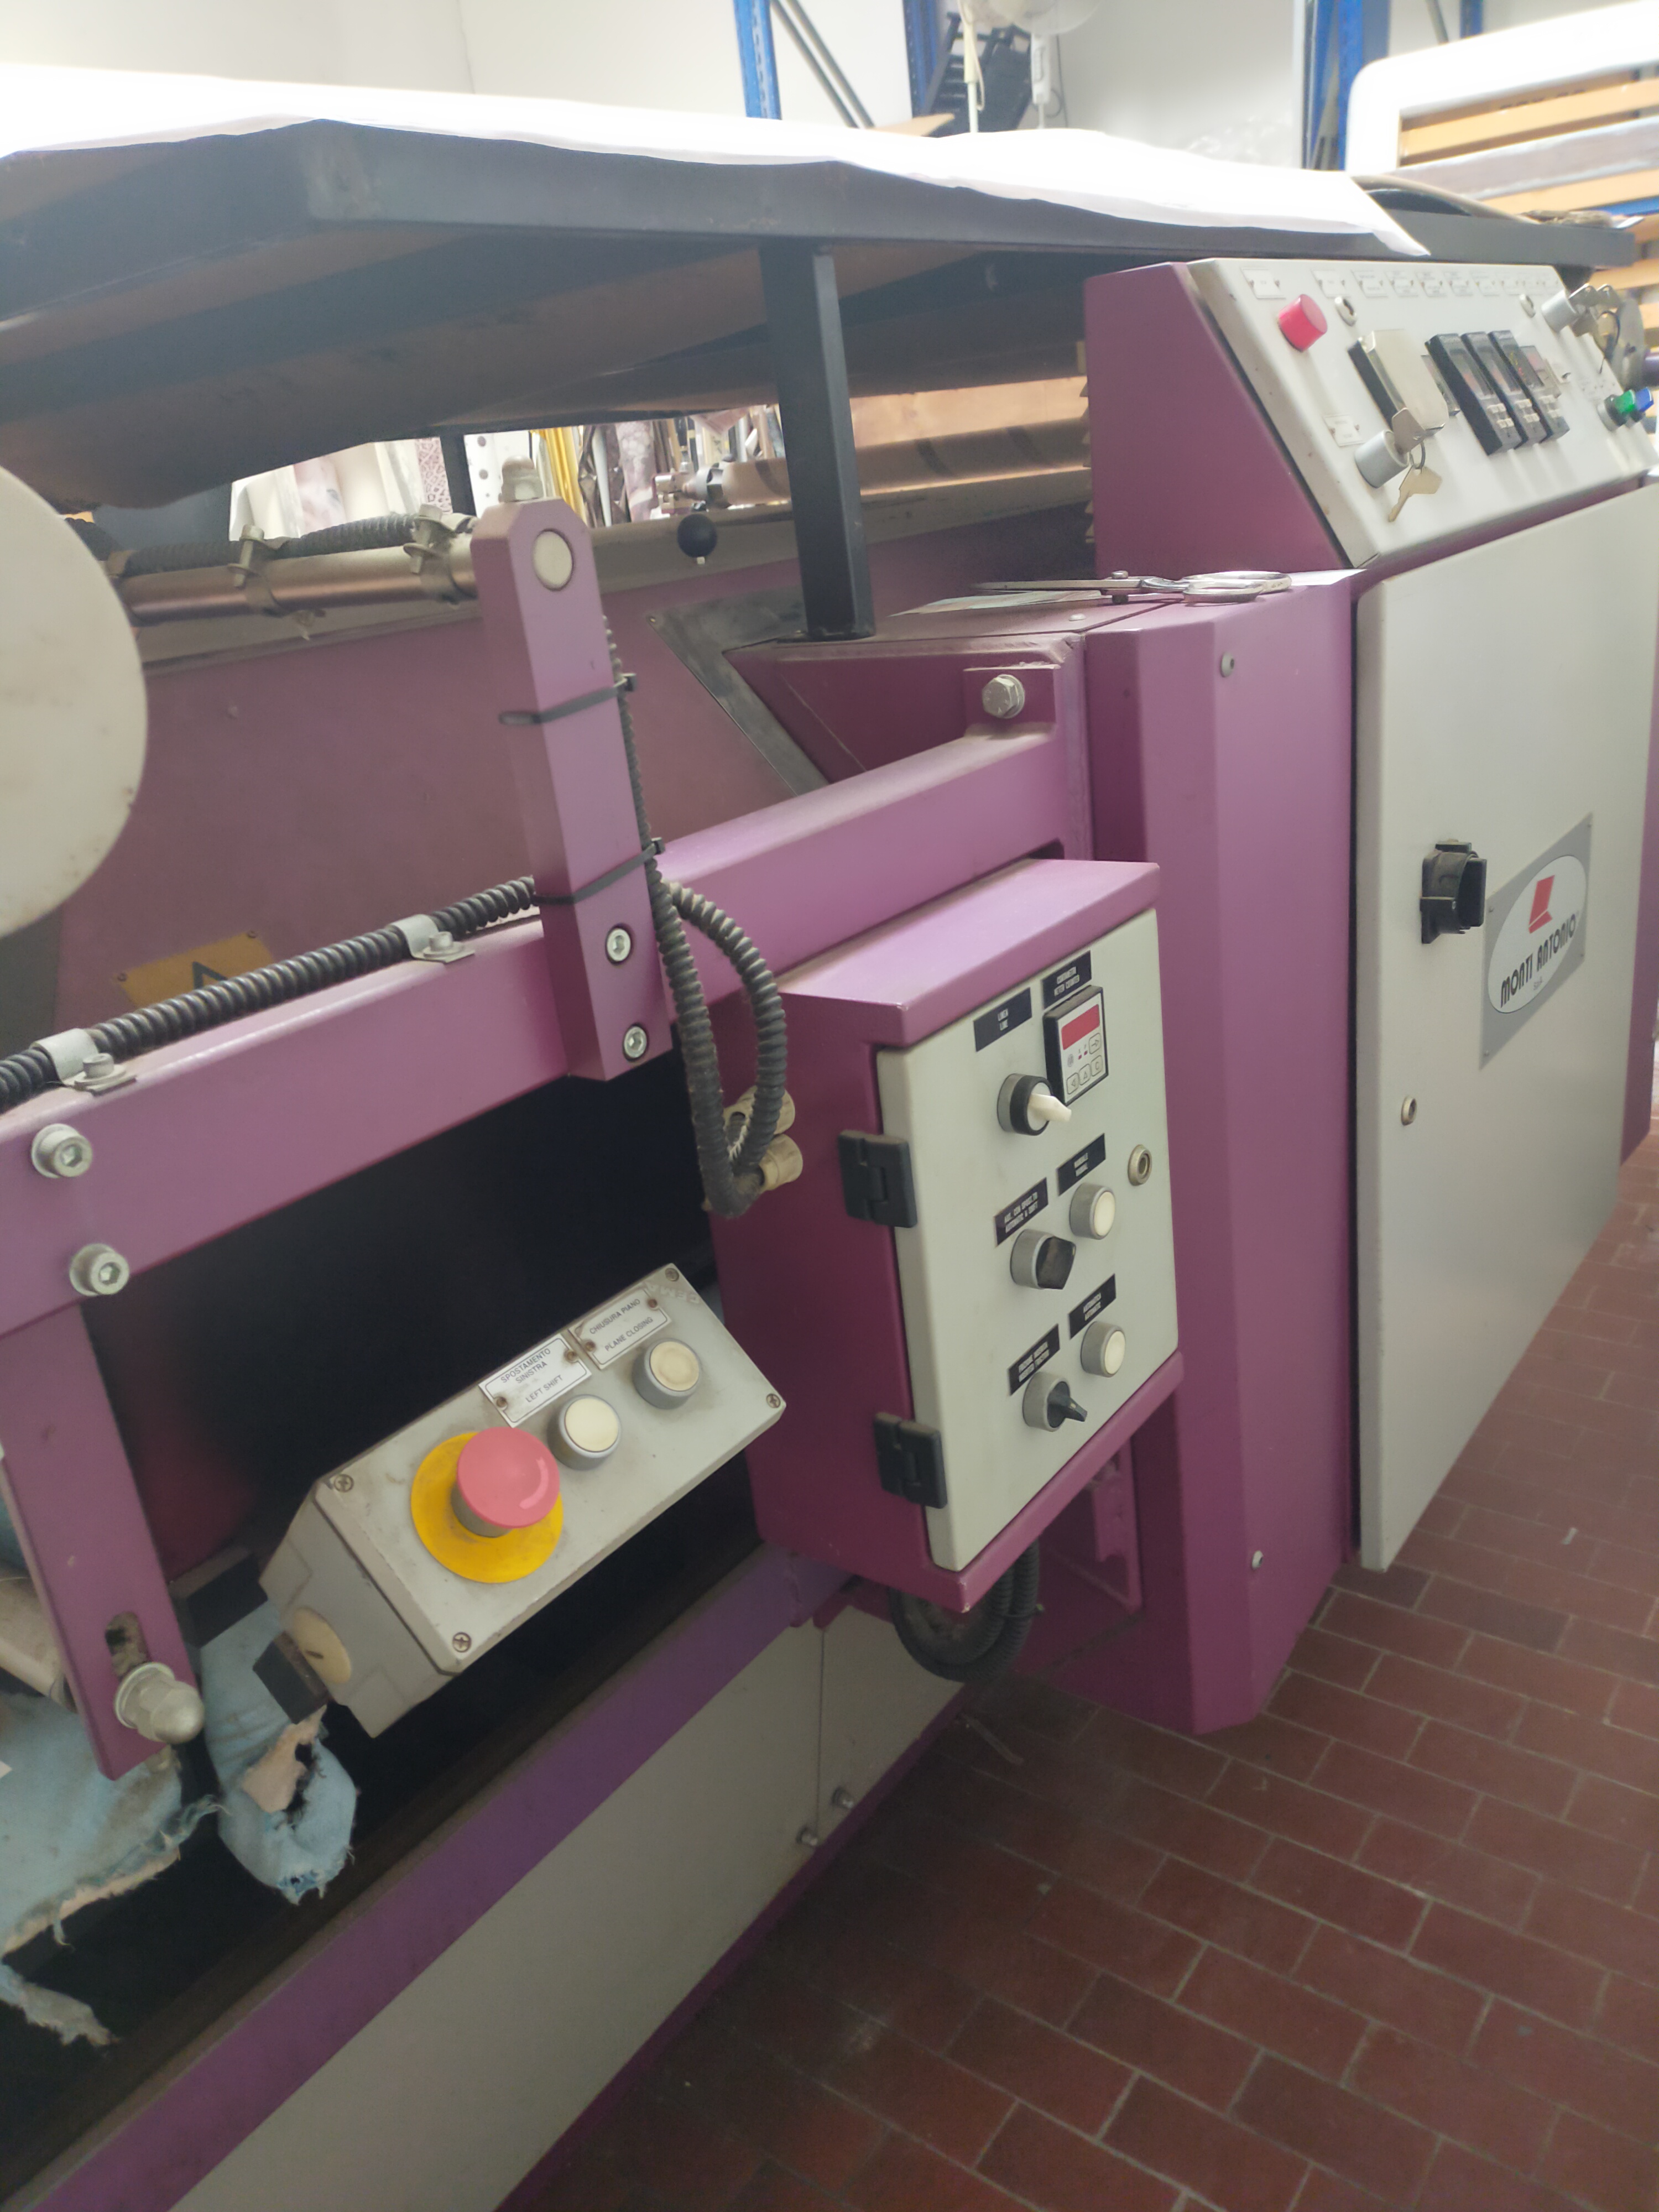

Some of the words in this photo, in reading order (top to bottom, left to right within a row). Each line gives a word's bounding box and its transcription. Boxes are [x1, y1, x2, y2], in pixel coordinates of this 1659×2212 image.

[1501, 953, 1533, 1008] MONTI
[589, 1311, 622, 1334] CHIUSURA
[620, 1298, 640, 1314] PIANO
[604, 1333, 627, 1352] PLANE
[626, 1316, 653, 1337] CLOSING
[500, 1348, 551, 1383] SPOSTAMENTO
[515, 1361, 547, 1384] SINISTRA
[525, 1387, 544, 1403] LEFT
[543, 1374, 563, 1391] SHIFT
